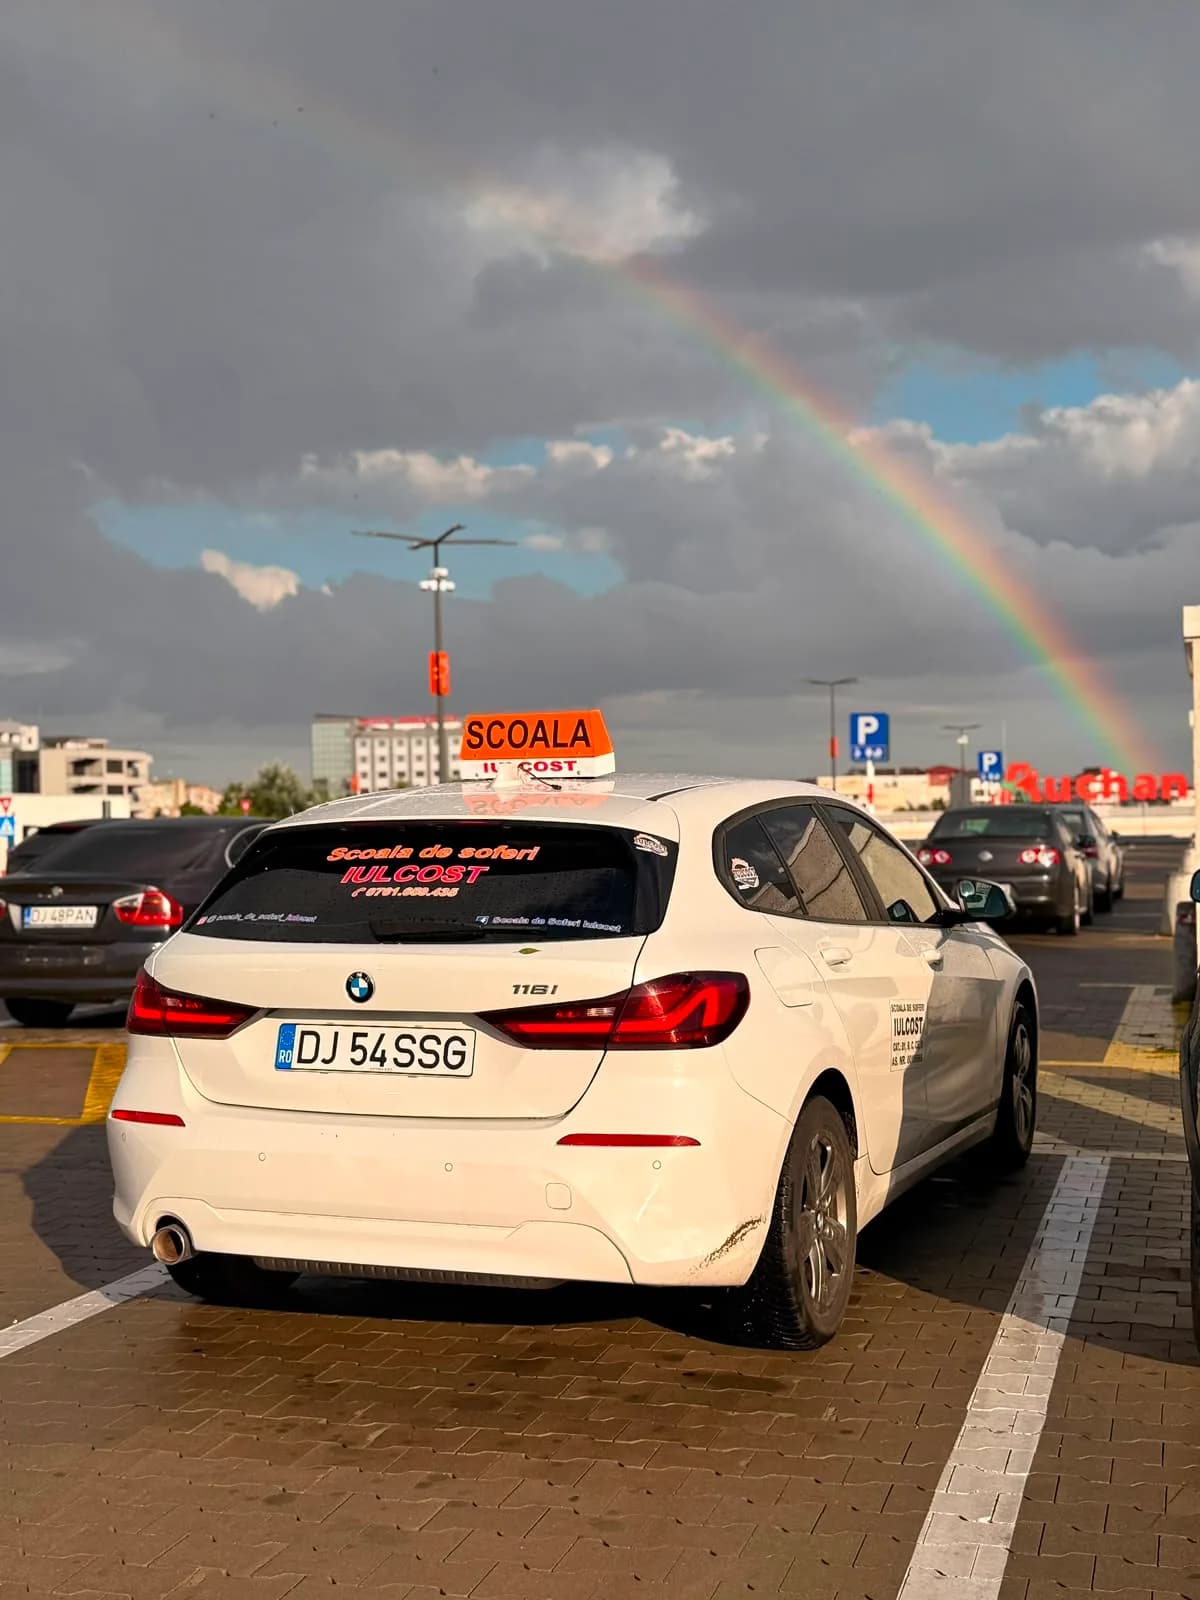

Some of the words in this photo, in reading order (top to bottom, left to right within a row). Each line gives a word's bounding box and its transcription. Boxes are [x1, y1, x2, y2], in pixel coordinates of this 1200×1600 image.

[466, 719, 591, 749] SCOALA
[857, 715, 879, 745] P
[483, 760, 577, 773] IUCOST
[982, 752, 998, 772] P
[1003, 762, 1189, 804] Auchan
[326, 845, 415, 862] Scoala
[419, 844, 454, 859] de
[458, 845, 541, 862] soferi
[340, 864, 490, 884] IULCOST
[893, 1017, 923, 1036] IULCOST
[278, 1049, 292, 1064] RO
[296, 1030, 339, 1066] DJ
